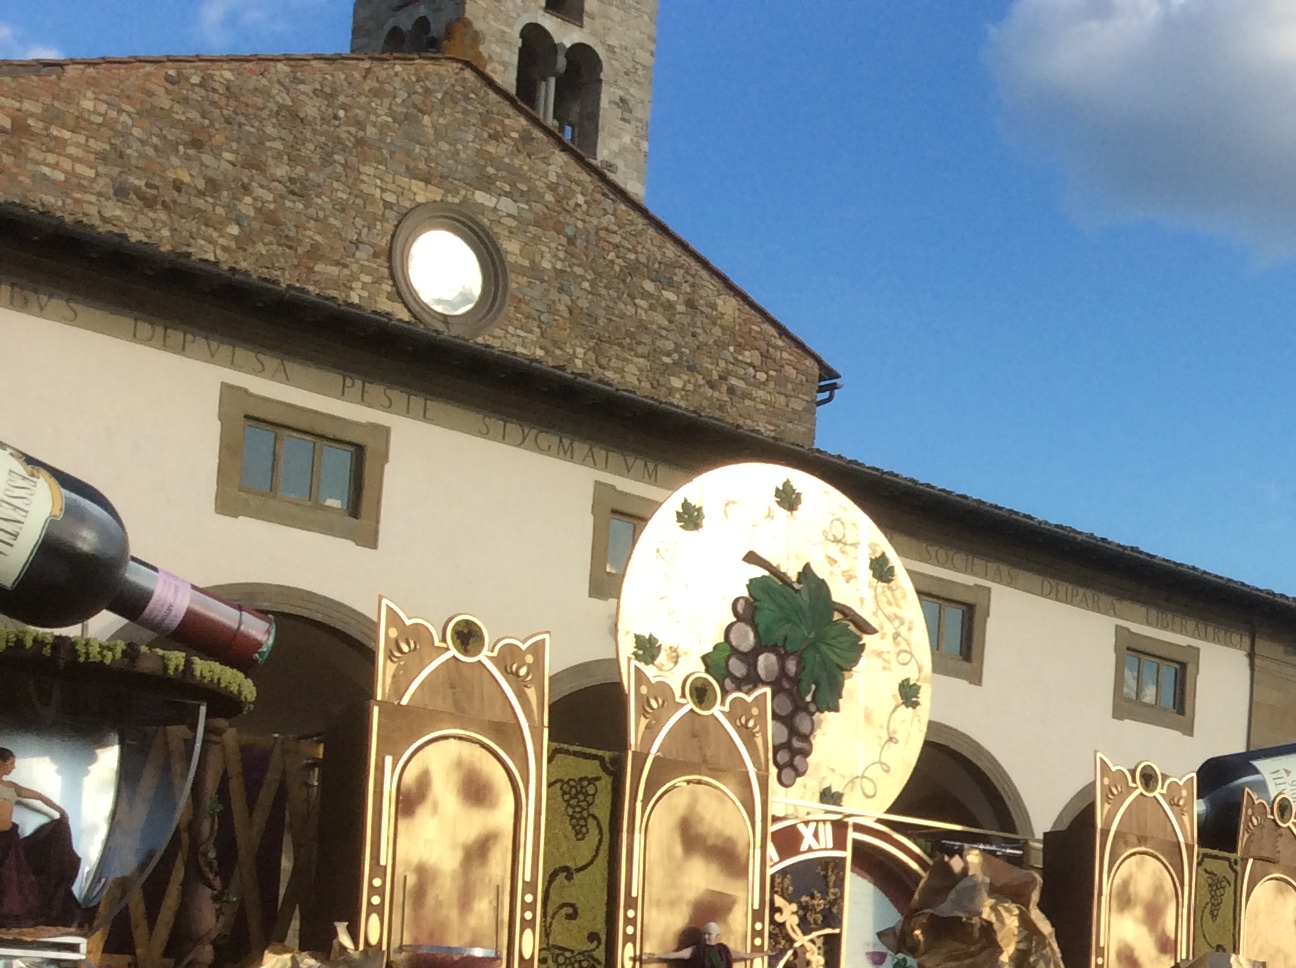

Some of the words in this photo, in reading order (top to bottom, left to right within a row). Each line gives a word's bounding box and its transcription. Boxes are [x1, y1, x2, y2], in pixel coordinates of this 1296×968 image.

[131, 316, 291, 382] DEPVLSA
[339, 374, 436, 423] PESTE
[477, 414, 660, 485] STYGMATVM
[924, 542, 1014, 586] SOCIETAS
[1145, 607, 1245, 651] LIBERATRICI
[796, 820, 833, 852] XII
